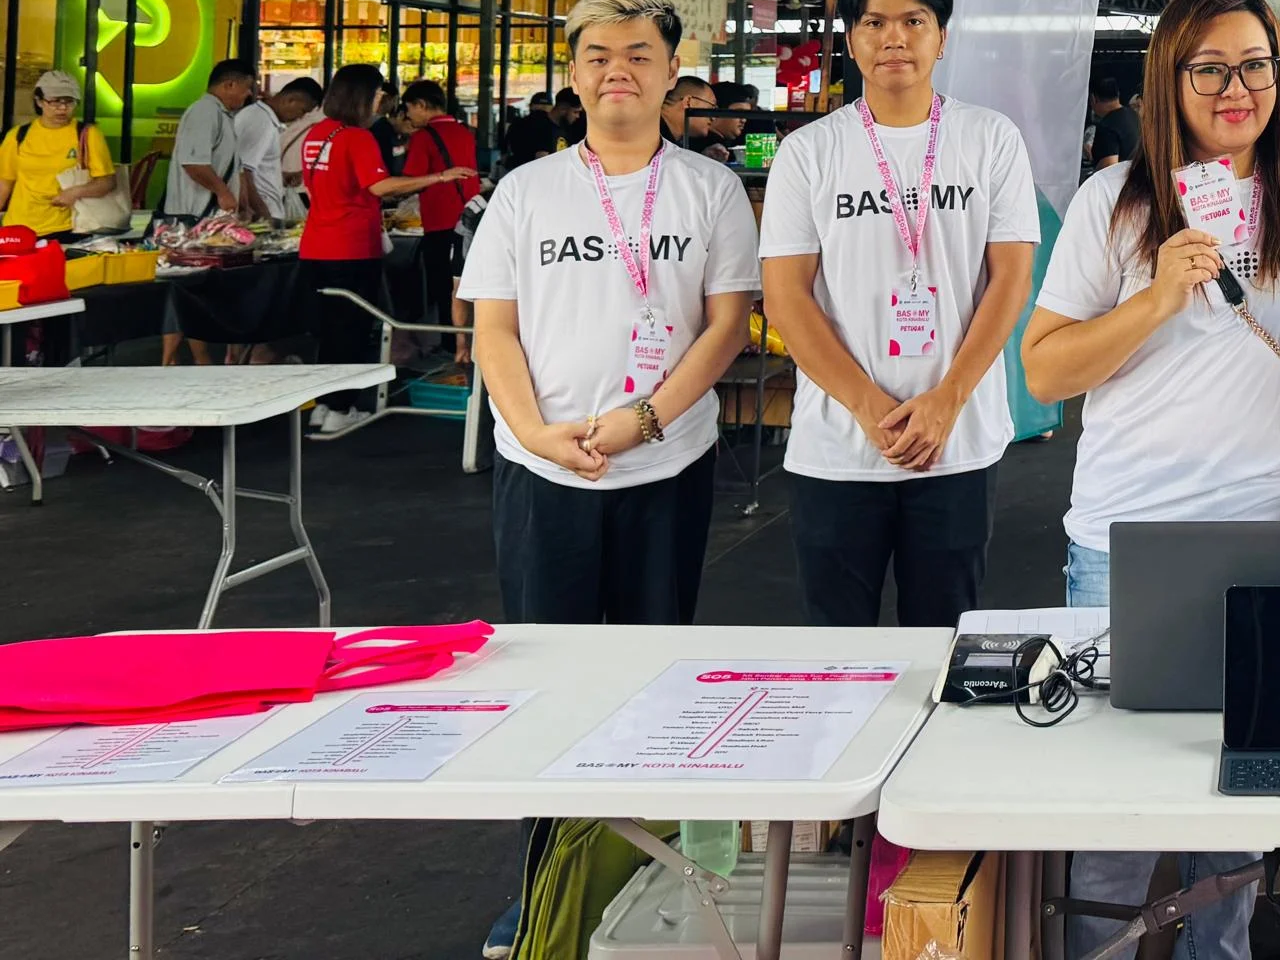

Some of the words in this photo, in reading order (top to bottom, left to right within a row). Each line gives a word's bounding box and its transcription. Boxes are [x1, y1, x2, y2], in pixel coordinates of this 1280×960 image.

[836, 190, 893, 220] BAS
[931, 184, 975, 211] MY
[1190, 194, 1209, 207] BAS
[1216, 187, 1231, 199] MY
[1200, 207, 1231, 222] PETUGAS
[540, 235, 604, 266] BAS
[649, 235, 692, 262] MY
[918, 309, 930, 317] MY
[635, 346, 649, 354] BAS
[655, 347, 666, 355] MY
